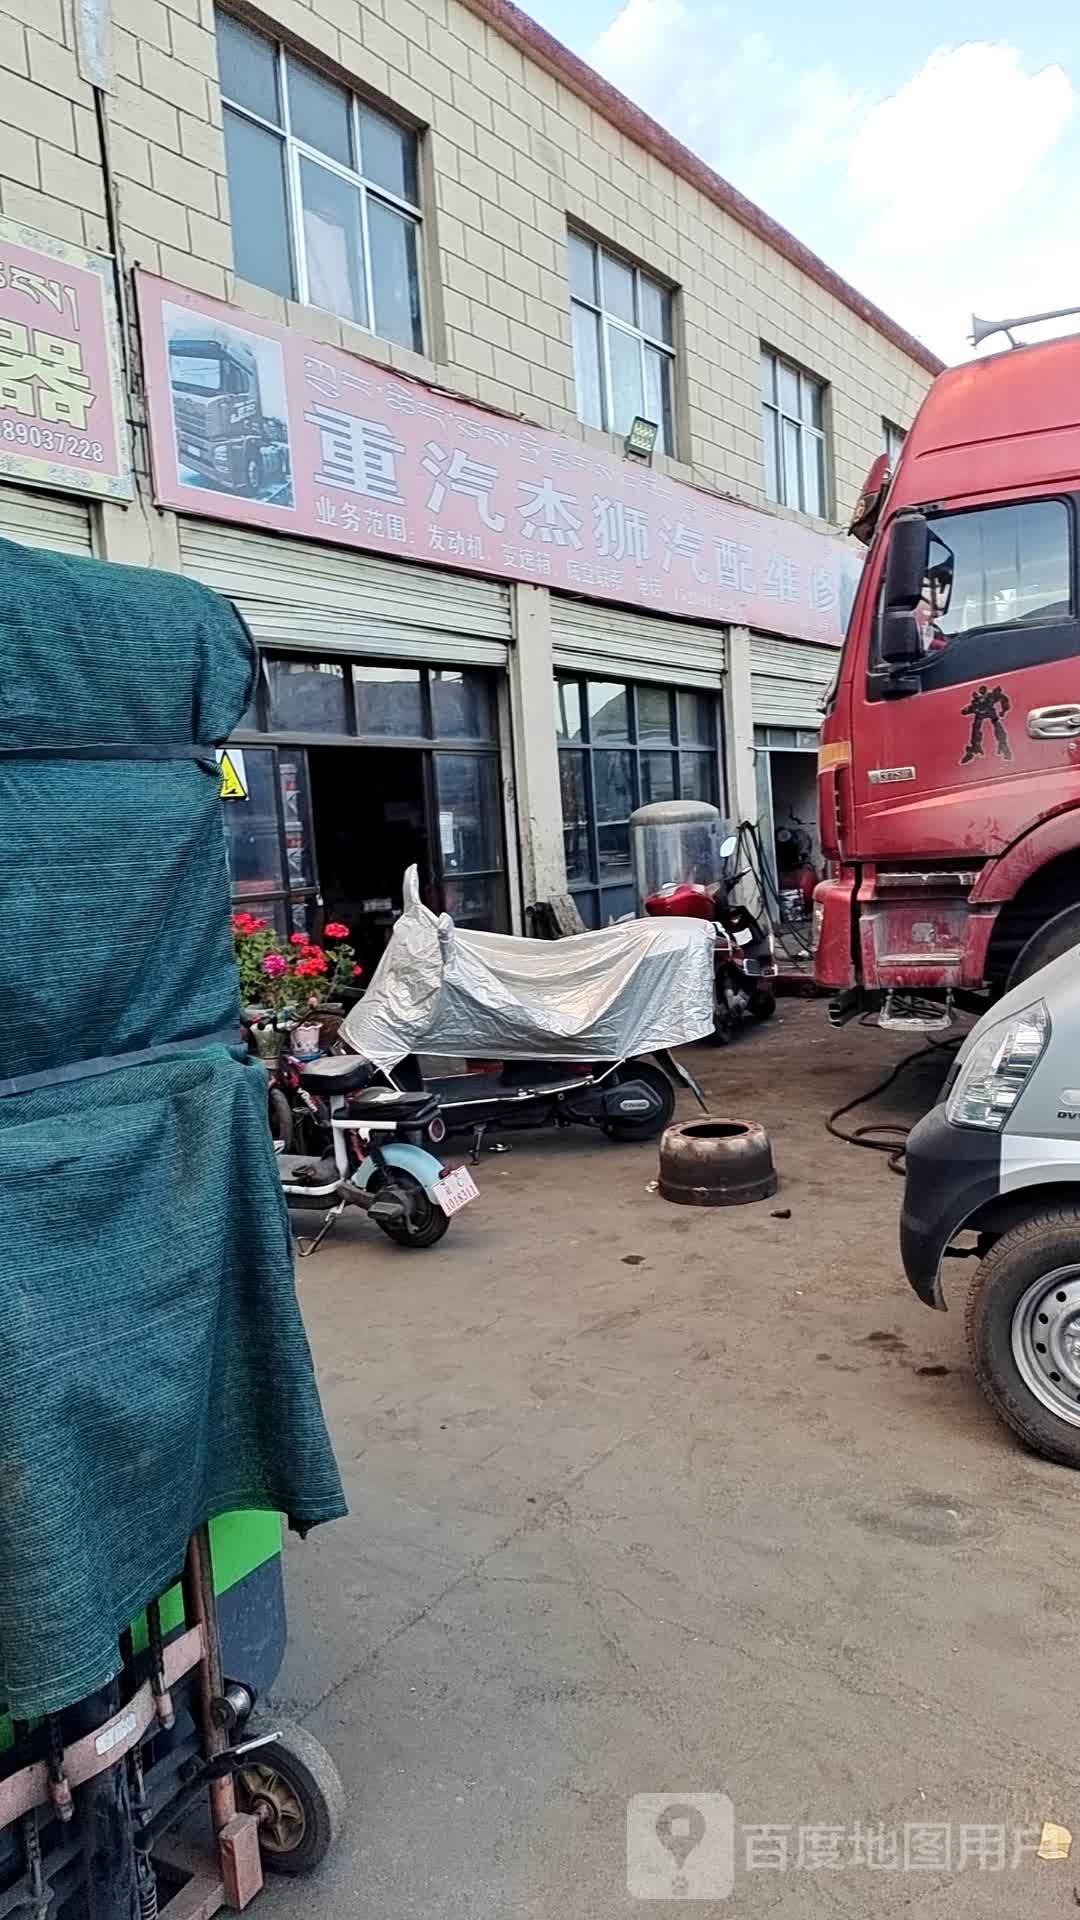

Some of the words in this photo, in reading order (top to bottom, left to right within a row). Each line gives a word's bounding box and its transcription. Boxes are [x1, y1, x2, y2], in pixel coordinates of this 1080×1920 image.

[0, 418, 104, 463] 89037228
[303, 400, 839, 616] 重汽杰狮汽配维修
